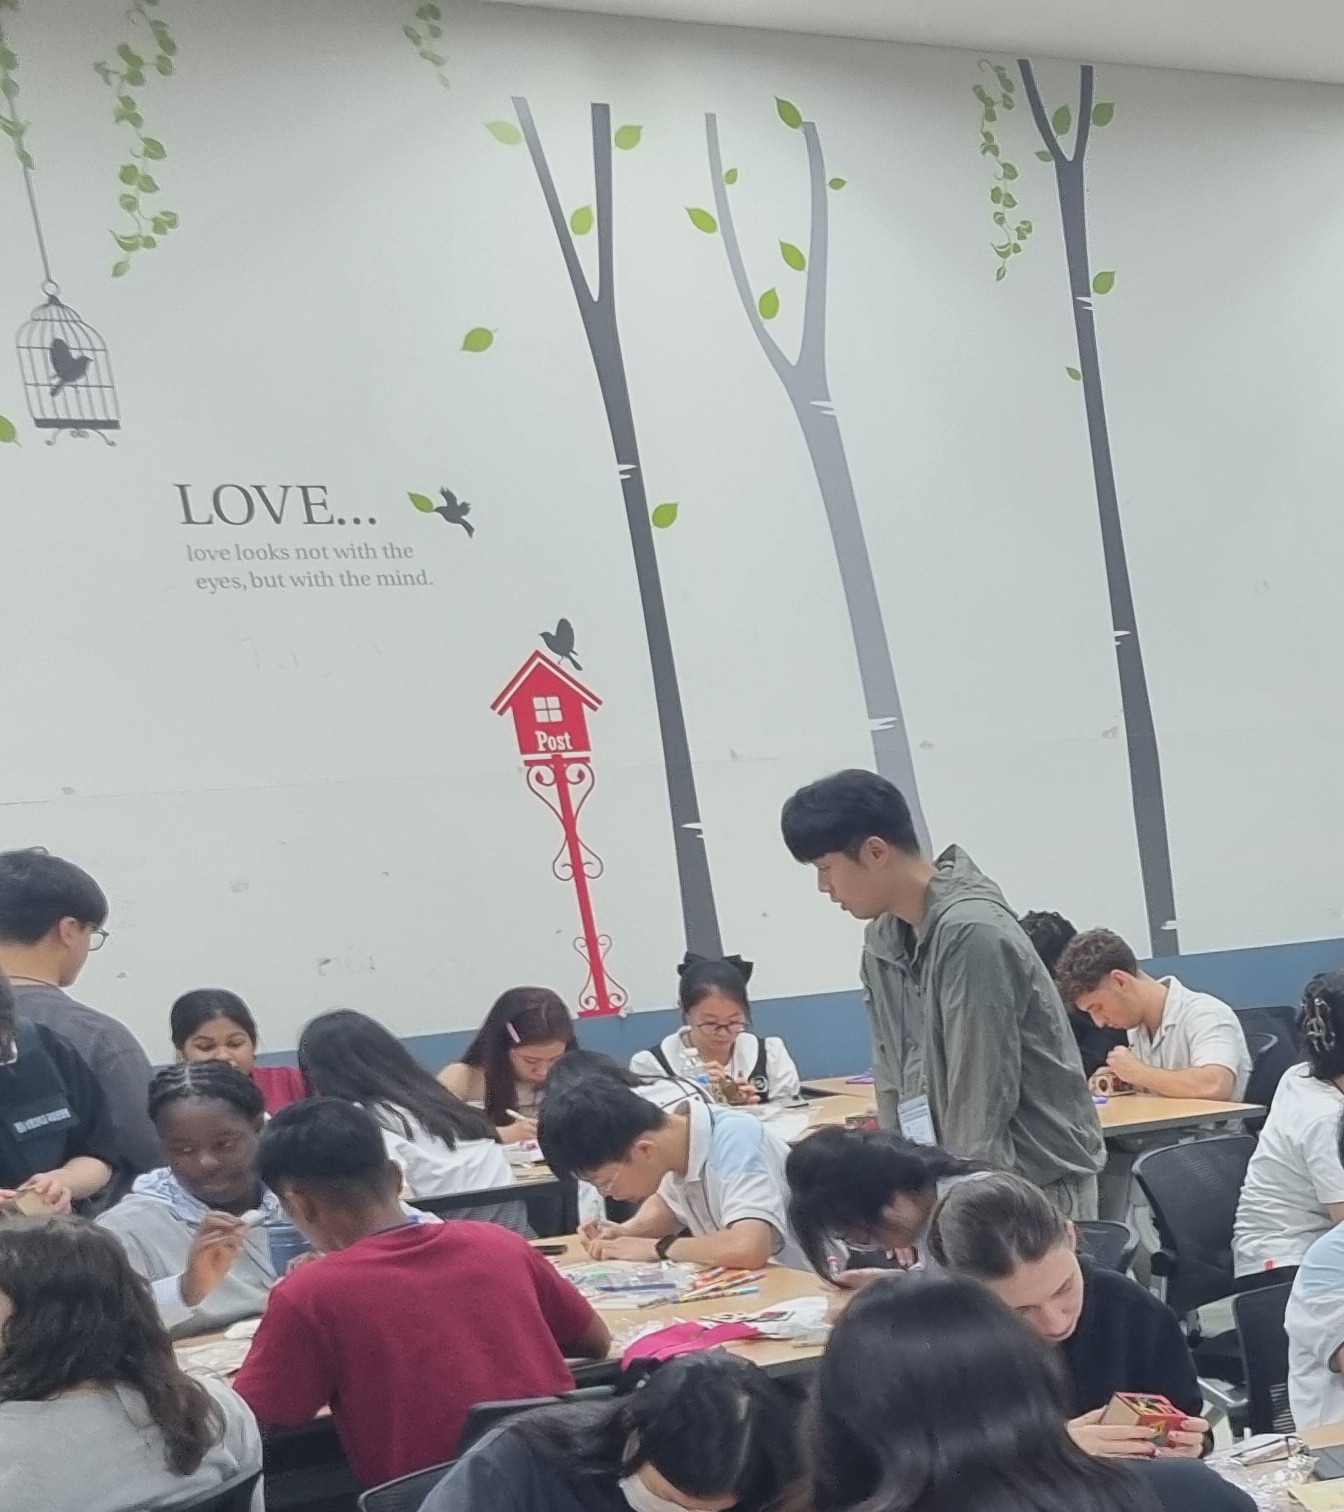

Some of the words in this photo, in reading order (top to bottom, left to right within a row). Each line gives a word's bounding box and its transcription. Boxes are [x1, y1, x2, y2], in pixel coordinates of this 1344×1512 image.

[173, 483, 377, 526] LOVE...
[187, 544, 231, 562] love
[234, 543, 290, 561] looks
[294, 546, 330, 561] not
[332, 543, 376, 560] with
[381, 542, 414, 560] the
[196, 573, 247, 594] eyes,
[249, 571, 286, 589] but
[289, 570, 335, 588] with
[339, 570, 371, 587] the
[376, 569, 434, 587] mind.
[535, 730, 573, 752] Post
